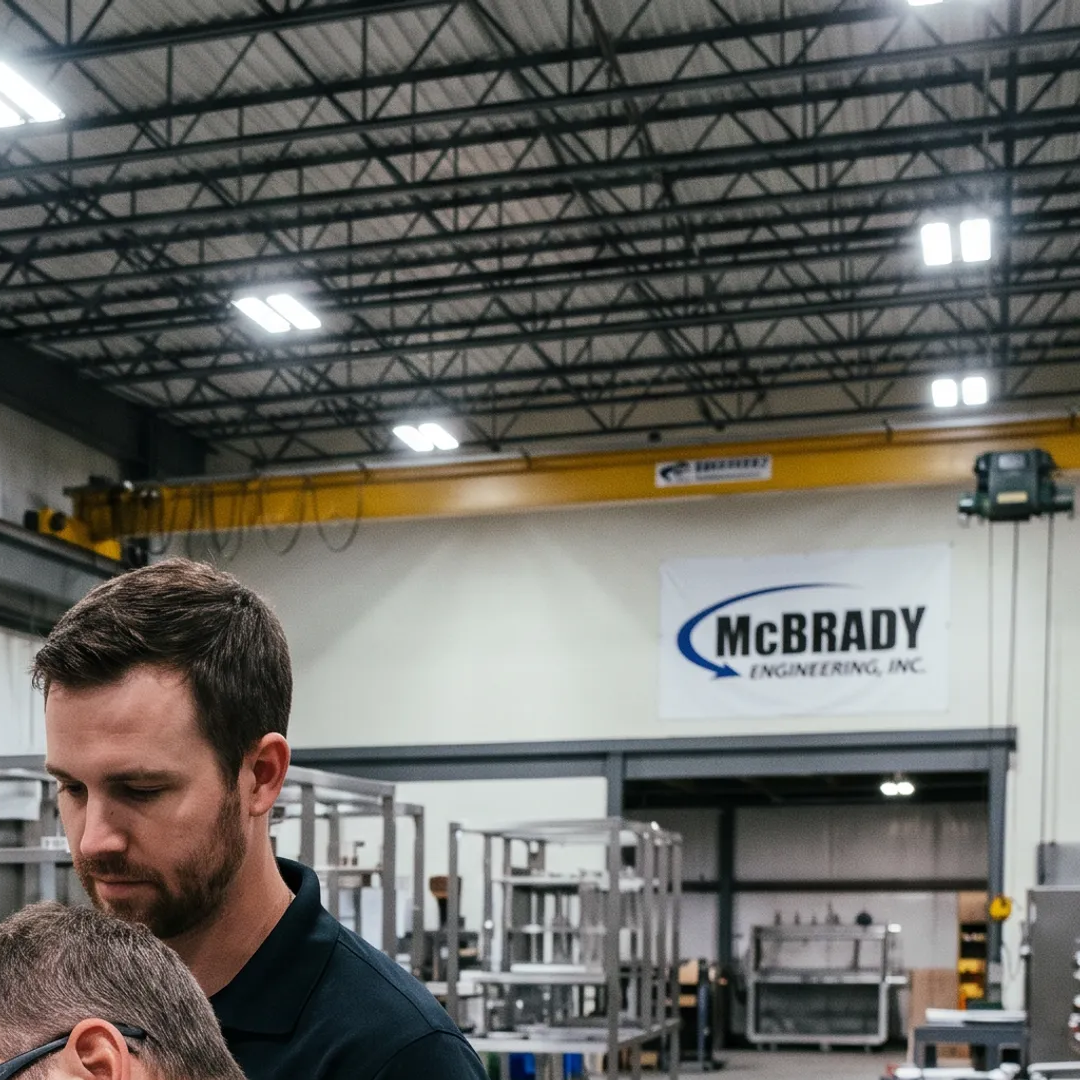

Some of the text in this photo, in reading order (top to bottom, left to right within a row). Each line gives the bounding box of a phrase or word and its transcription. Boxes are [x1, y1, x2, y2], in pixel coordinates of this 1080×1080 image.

[716, 606, 926, 659] McBRADY
[749, 657, 926, 680] ENGINEERING, INC.
